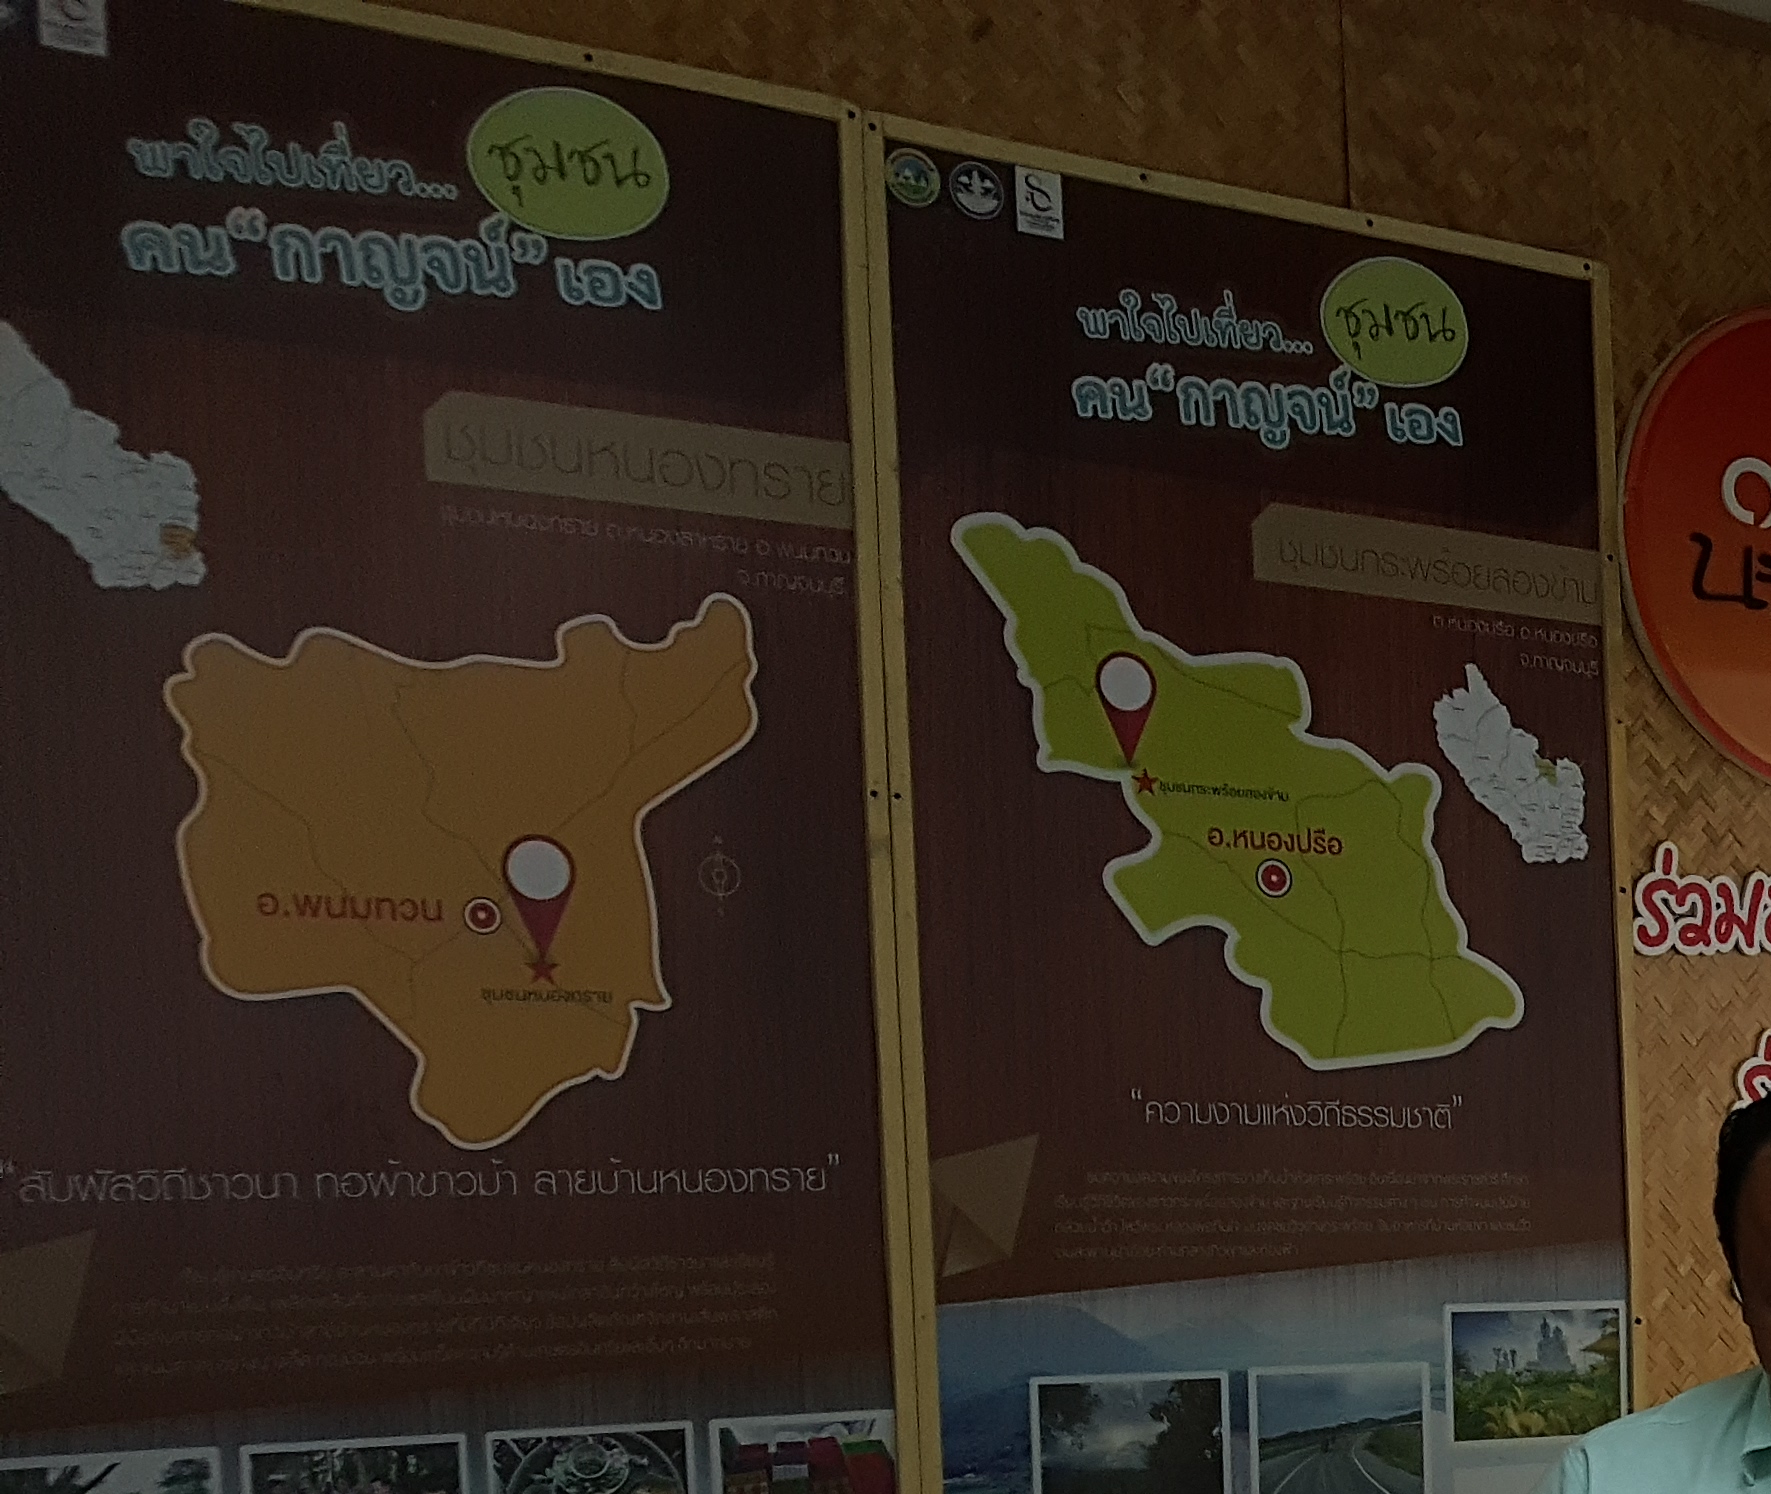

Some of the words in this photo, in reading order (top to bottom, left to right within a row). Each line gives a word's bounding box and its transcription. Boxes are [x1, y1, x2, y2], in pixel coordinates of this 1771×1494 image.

[488, 132, 652, 209] ชุมชน
[555, 254, 664, 311] เอง
[1336, 298, 1457, 359] ชุมชน
[1384, 396, 1465, 448] เอง
[1206, 822, 1344, 858] อ.หนองปรือ
[255, 889, 445, 926] อ.พนมทวน
